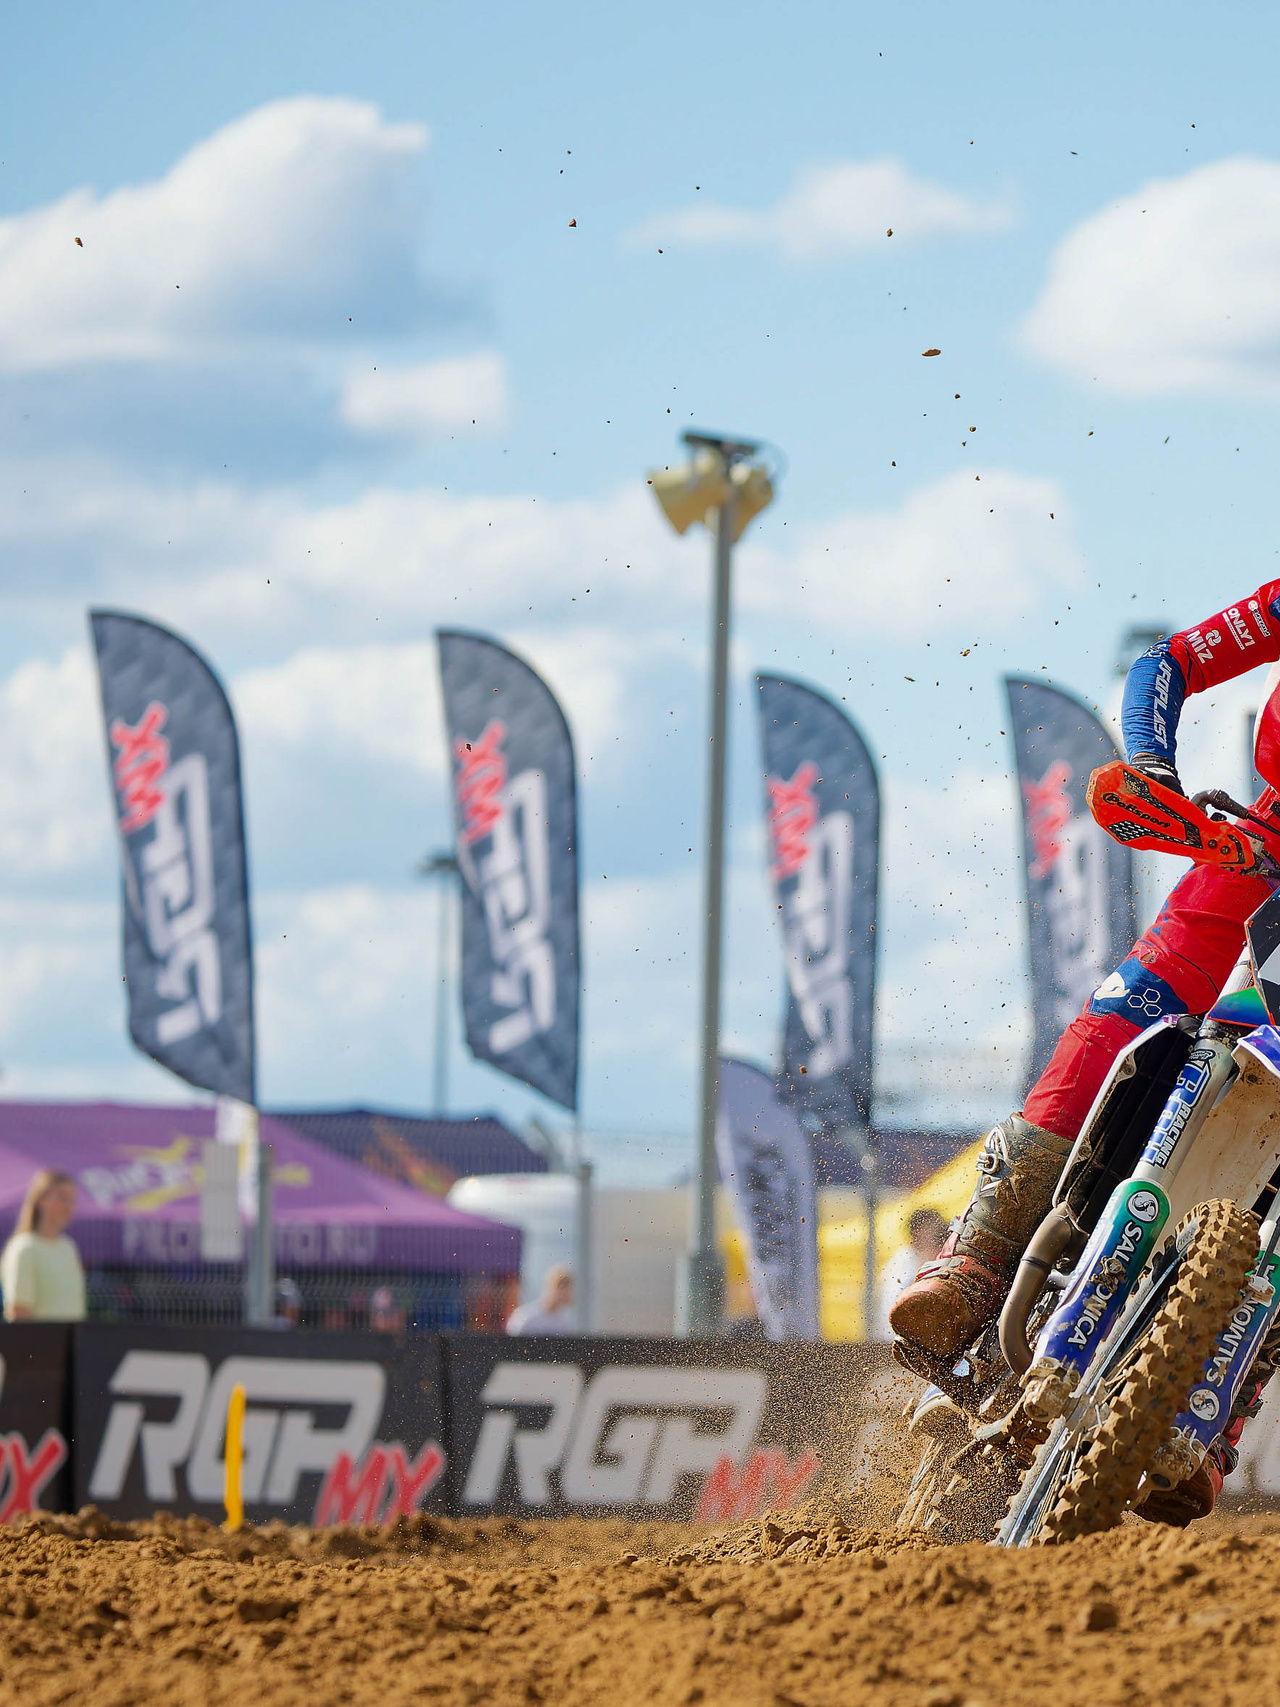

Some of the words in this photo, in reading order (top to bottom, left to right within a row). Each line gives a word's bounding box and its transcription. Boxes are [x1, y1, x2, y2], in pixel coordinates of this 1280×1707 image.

[1187, 630, 1214, 664] MIZ
[1155, 1103, 1192, 1168] RACING
[1067, 1221, 1143, 1345] SALONICA
[87, 1350, 388, 1506] RGP
[463, 1361, 768, 1505] RGP
